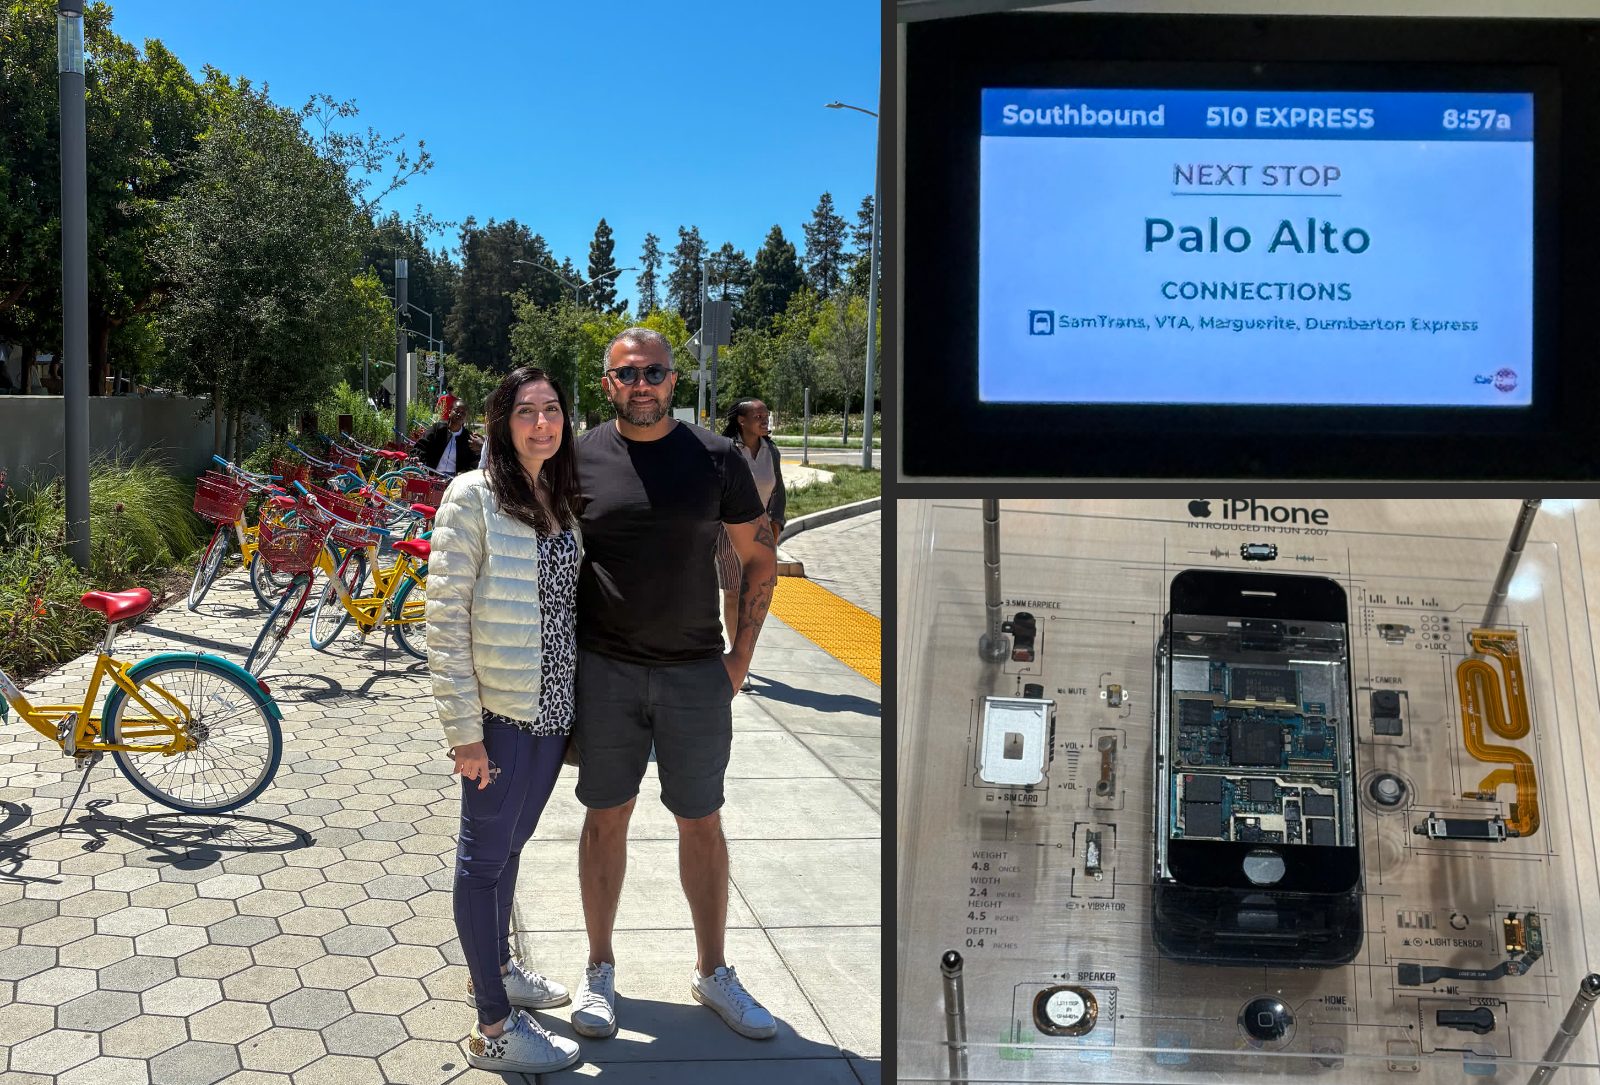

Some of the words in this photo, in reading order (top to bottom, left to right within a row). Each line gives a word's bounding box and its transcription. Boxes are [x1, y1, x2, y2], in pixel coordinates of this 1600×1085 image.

[1002, 104, 1165, 127] Southbound
[1206, 106, 1248, 127] 510
[1256, 107, 1375, 129] EXPRESS
[1442, 109, 1511, 130] 8:57a
[1173, 163, 1252, 187] NEXT
[1262, 165, 1341, 187] STOP
[1145, 216, 1251, 253] Palo
[1267, 217, 1370, 254] Alto
[1161, 281, 1352, 301] CONNECTIONS
[1058, 314, 1151, 332] SamTrans,
[1155, 316, 1195, 332] VTA,
[1411, 317, 1479, 334] Express
[1223, 498, 1329, 526] iPhone
[1187, 521, 1261, 532] INTRODUCED
[1279, 526, 1301, 535] JUN
[1304, 528, 1329, 537] 2007
[1429, 643, 1448, 651] LOCK
[1375, 676, 1403, 685] CAMERA
[1068, 687, 1088, 695] MUTE
[1065, 742, 1079, 750] VOL
[1003, 793, 1017, 801] SIM
[1018, 794, 1039, 803] CARD
[972, 851, 1008, 860] WEIGHT
[971, 862, 990, 871] 4.8
[970, 876, 1001, 885] WIDTH
[969, 887, 988, 898] 2.4
[968, 900, 1003, 909] HEIGHT
[1087, 902, 1126, 911] VIBRATOR
[967, 911, 987, 921] 4.5
[965, 927, 997, 936] DEPTH
[965, 938, 985, 949] 0.4
[1429, 938, 1451, 947] LIGHT
[1453, 938, 1484, 947] SENSOR
[1077, 972, 1116, 981] SPEAKER
[1446, 986, 1460, 995] MIC
[1324, 995, 1347, 1005] HOME
